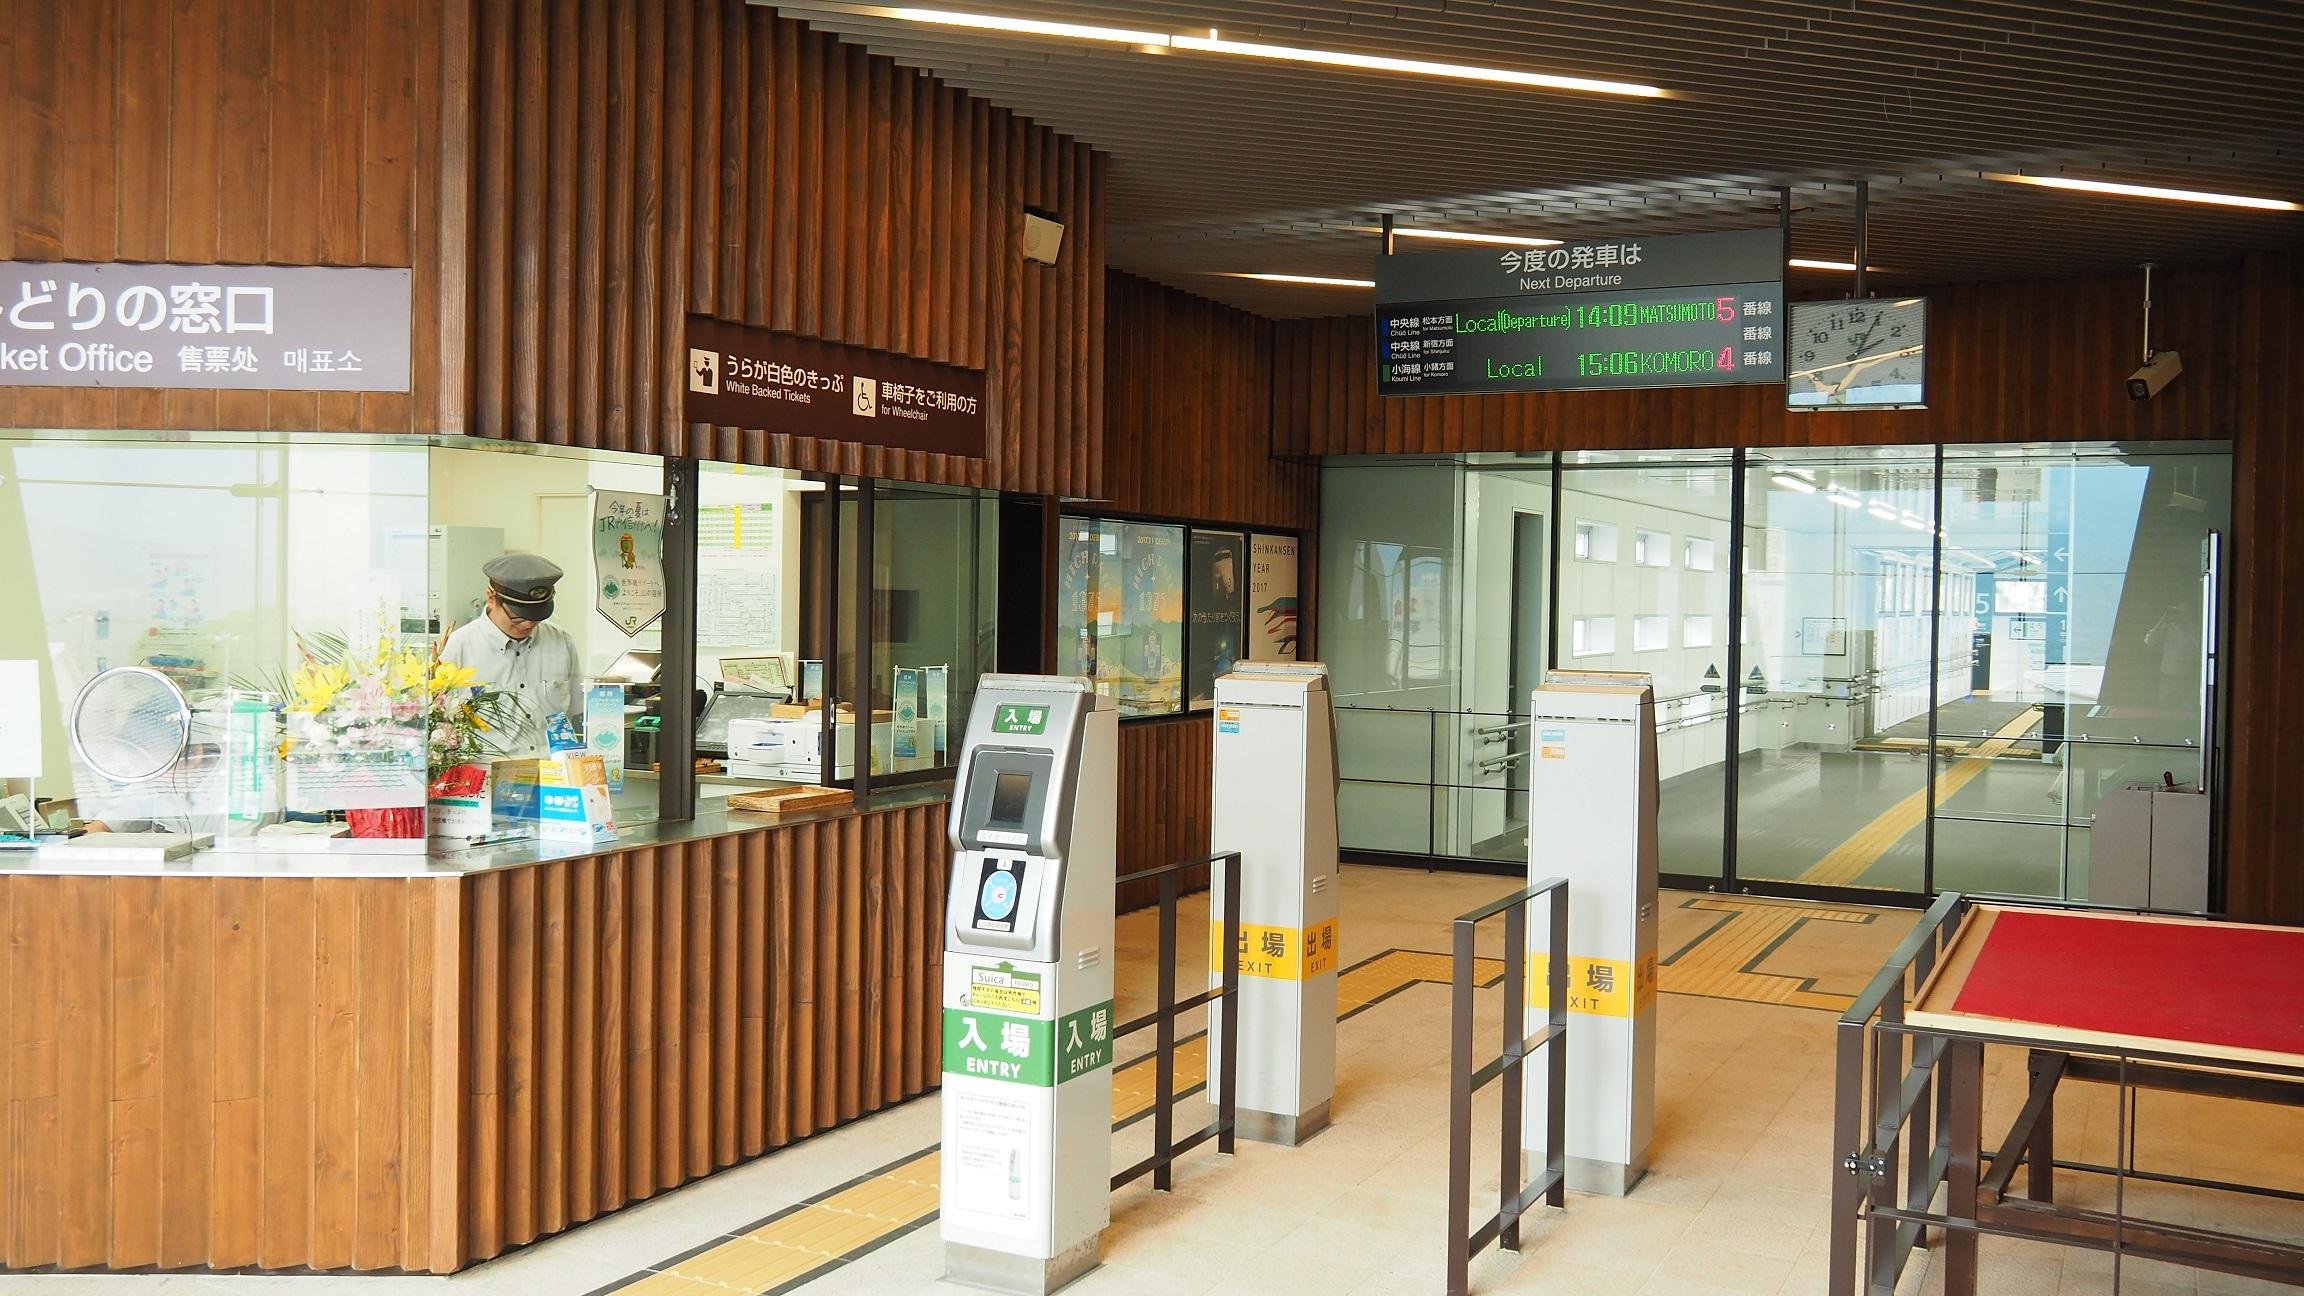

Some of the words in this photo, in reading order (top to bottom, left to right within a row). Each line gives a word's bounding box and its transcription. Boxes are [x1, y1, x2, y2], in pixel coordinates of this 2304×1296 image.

[1500, 244, 1642, 273] 今度の発車は
[1520, 276, 1550, 290] Next
[1555, 273, 1622, 291] Departure
[0, 280, 274, 334] どりの窓口
[1576, 304, 1638, 329] 14:09
[1640, 302, 1715, 323] MATSUMOTO
[1716, 297, 1735, 321] 5
[1743, 301, 1772, 316] 番線
[1390, 317, 1420, 329] 中央線
[1422, 315, 1453, 326] 松本方面
[1407, 328, 1420, 336] Line
[1743, 326, 1772, 341] 番線
[1390, 340, 1420, 352] 中央線
[1423, 339, 1453, 349] 新宿方面
[0, 343, 48, 371] ket
[59, 342, 153, 371] Office
[178, 345, 258, 373] 售票处
[284, 348, 362, 373] 매표소
[1407, 352, 1421, 360] Line
[1487, 355, 1542, 379] Local
[1577, 351, 1638, 377] 15:06
[1640, 350, 1714, 374] KOMORO
[1716, 347, 1735, 371] 4
[1743, 351, 1772, 366] 番線
[726, 354, 844, 393] うらが白色のきっぷ
[1391, 363, 1421, 375] 小海線
[1423, 361, 1454, 371] 小諸方面
[1391, 375, 1409, 383] Koumi
[1409, 374, 1421, 382] Line
[726, 380, 750, 395] White
[752, 384, 781, 400] Backed
[784, 388, 811, 404] Tickets
[881, 381, 977, 415] 車椅子をご利用の方
[881, 404, 891, 415] for
[892, 405, 929, 421] Wheelchair
[609, 500, 650, 518] 今年の夏は
[1253, 543, 1295, 556] SHINKANSEN
[1252, 563, 1270, 574] YEAR
[1252, 582, 1268, 593] 2017
[1976, 592, 1990, 614] 5
[625, 616, 637, 625] JR
[1004, 708, 1043, 726] 入場
[1009, 724, 1033, 732] ENTRY
[1306, 925, 1332, 957] 出場
[1310, 957, 1327, 973] EXIT
[978, 972, 1004, 985] Suica
[1569, 995, 1600, 1010] XIT
[958, 1017, 1031, 1058] 入場
[1066, 1011, 1107, 1053] 入場
[966, 1056, 1021, 1079] ENTRY
[1071, 1049, 1102, 1074] ENTRY
